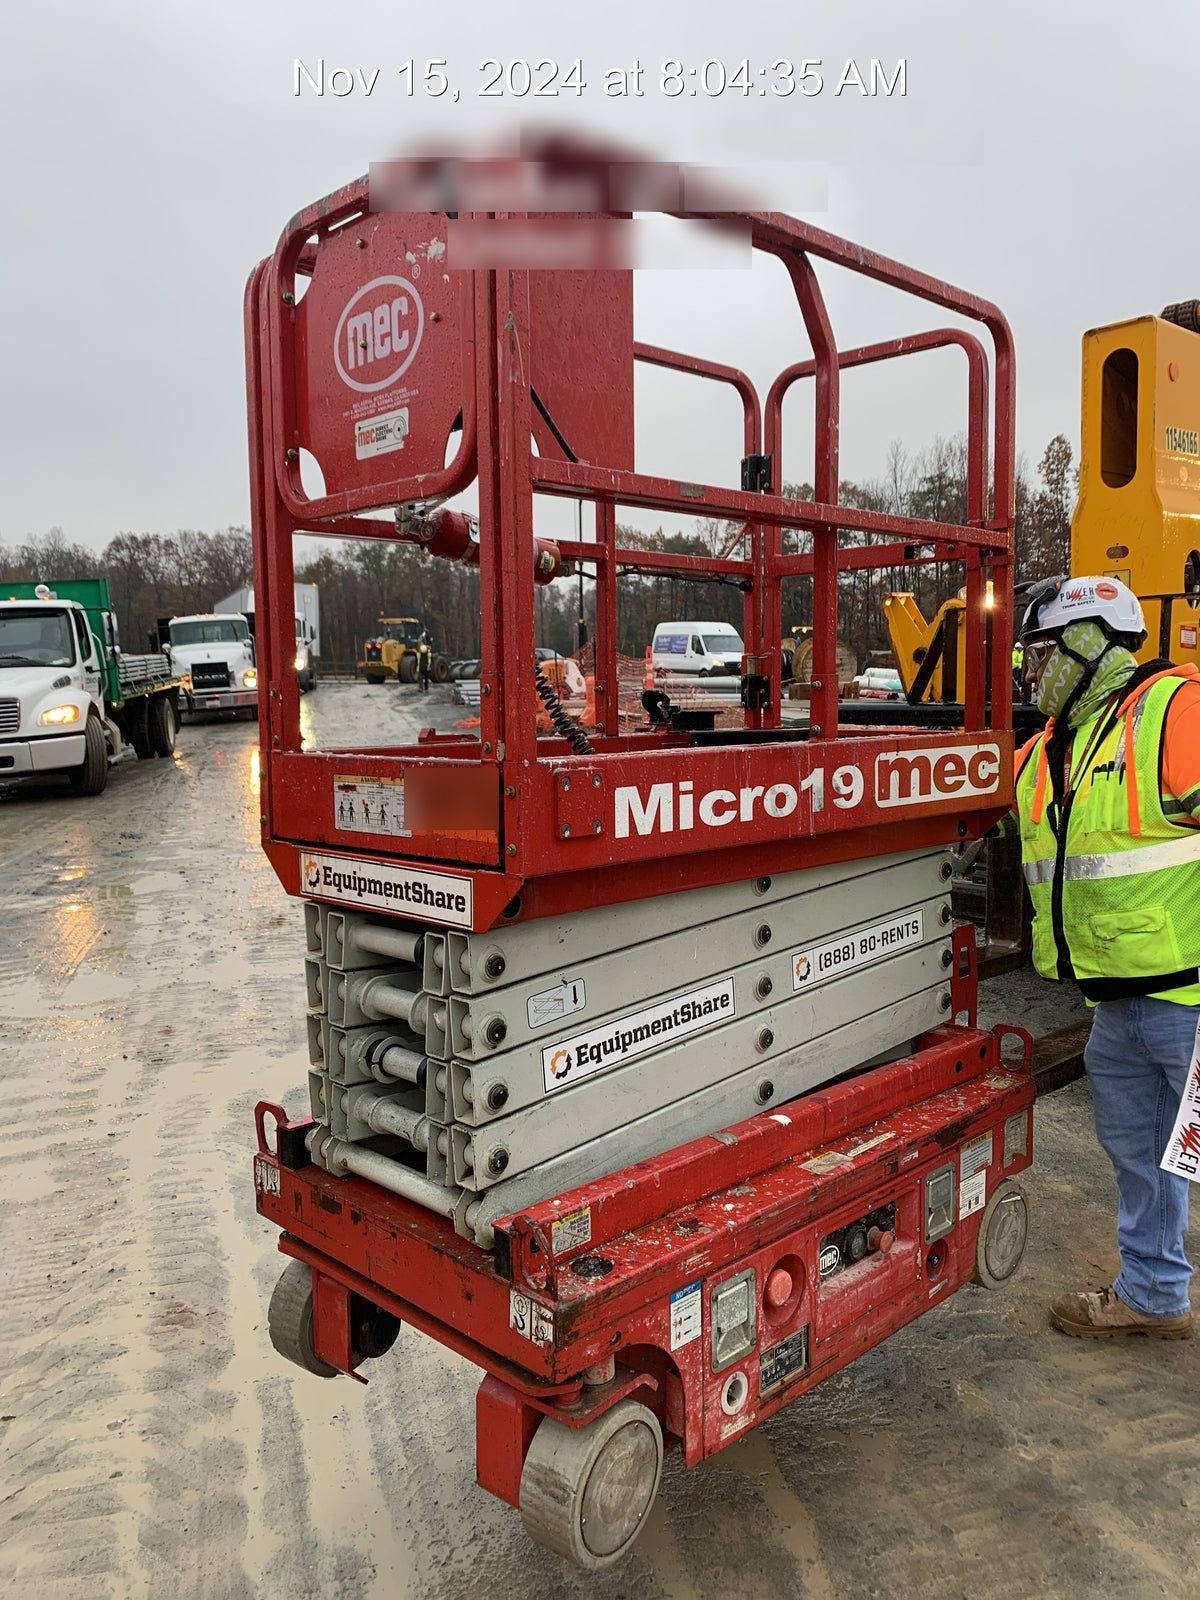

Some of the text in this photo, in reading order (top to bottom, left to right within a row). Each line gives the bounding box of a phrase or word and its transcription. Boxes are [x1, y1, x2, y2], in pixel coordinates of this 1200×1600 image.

[1166, 427, 1197, 454] 11546166
[614, 764, 865, 839] Micro19
[323, 866, 466, 912] EquipmentShare
[819, 920, 919, 971] (888) 80-RENTS
[575, 993, 730, 1067] EquipmentShare
